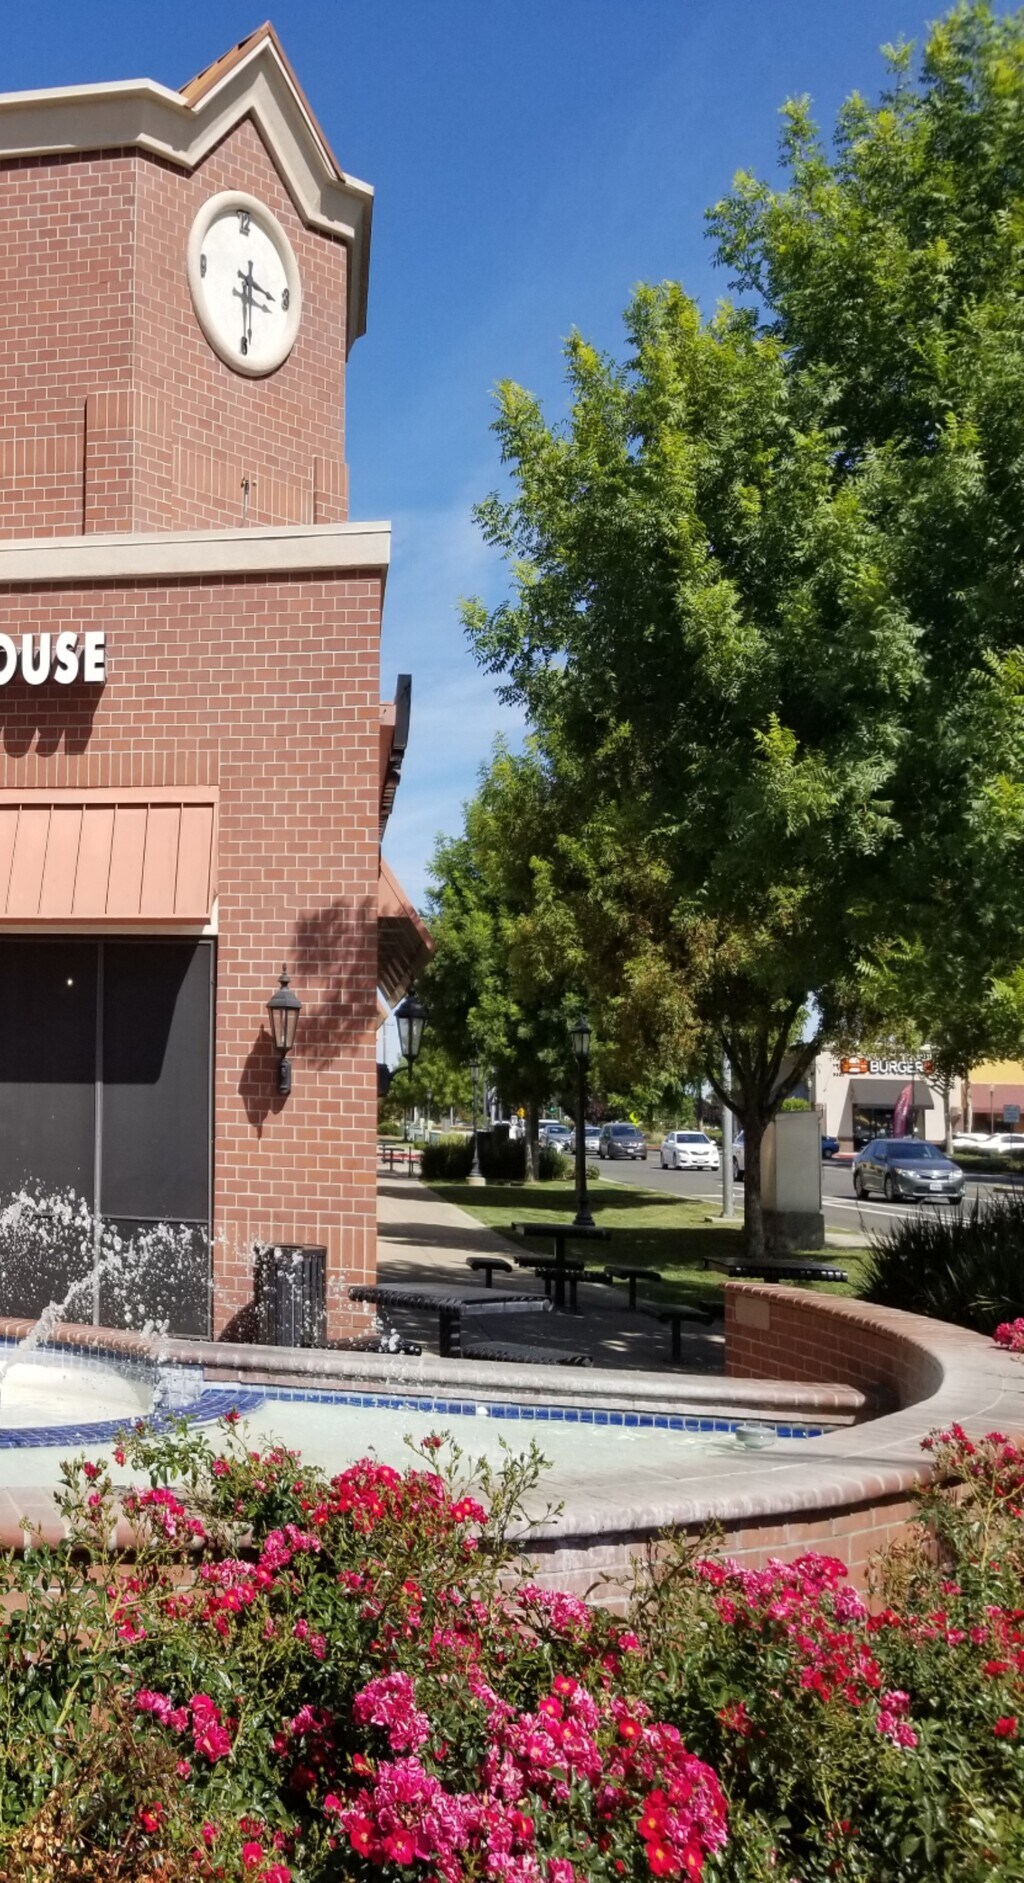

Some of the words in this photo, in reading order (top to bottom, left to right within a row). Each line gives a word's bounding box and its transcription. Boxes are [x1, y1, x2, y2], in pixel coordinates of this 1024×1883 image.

[237, 209, 251, 237] 12
[200, 253, 207, 279] 9
[281, 287, 290, 312] 3
[869, 1060, 924, 1074] BURGER
